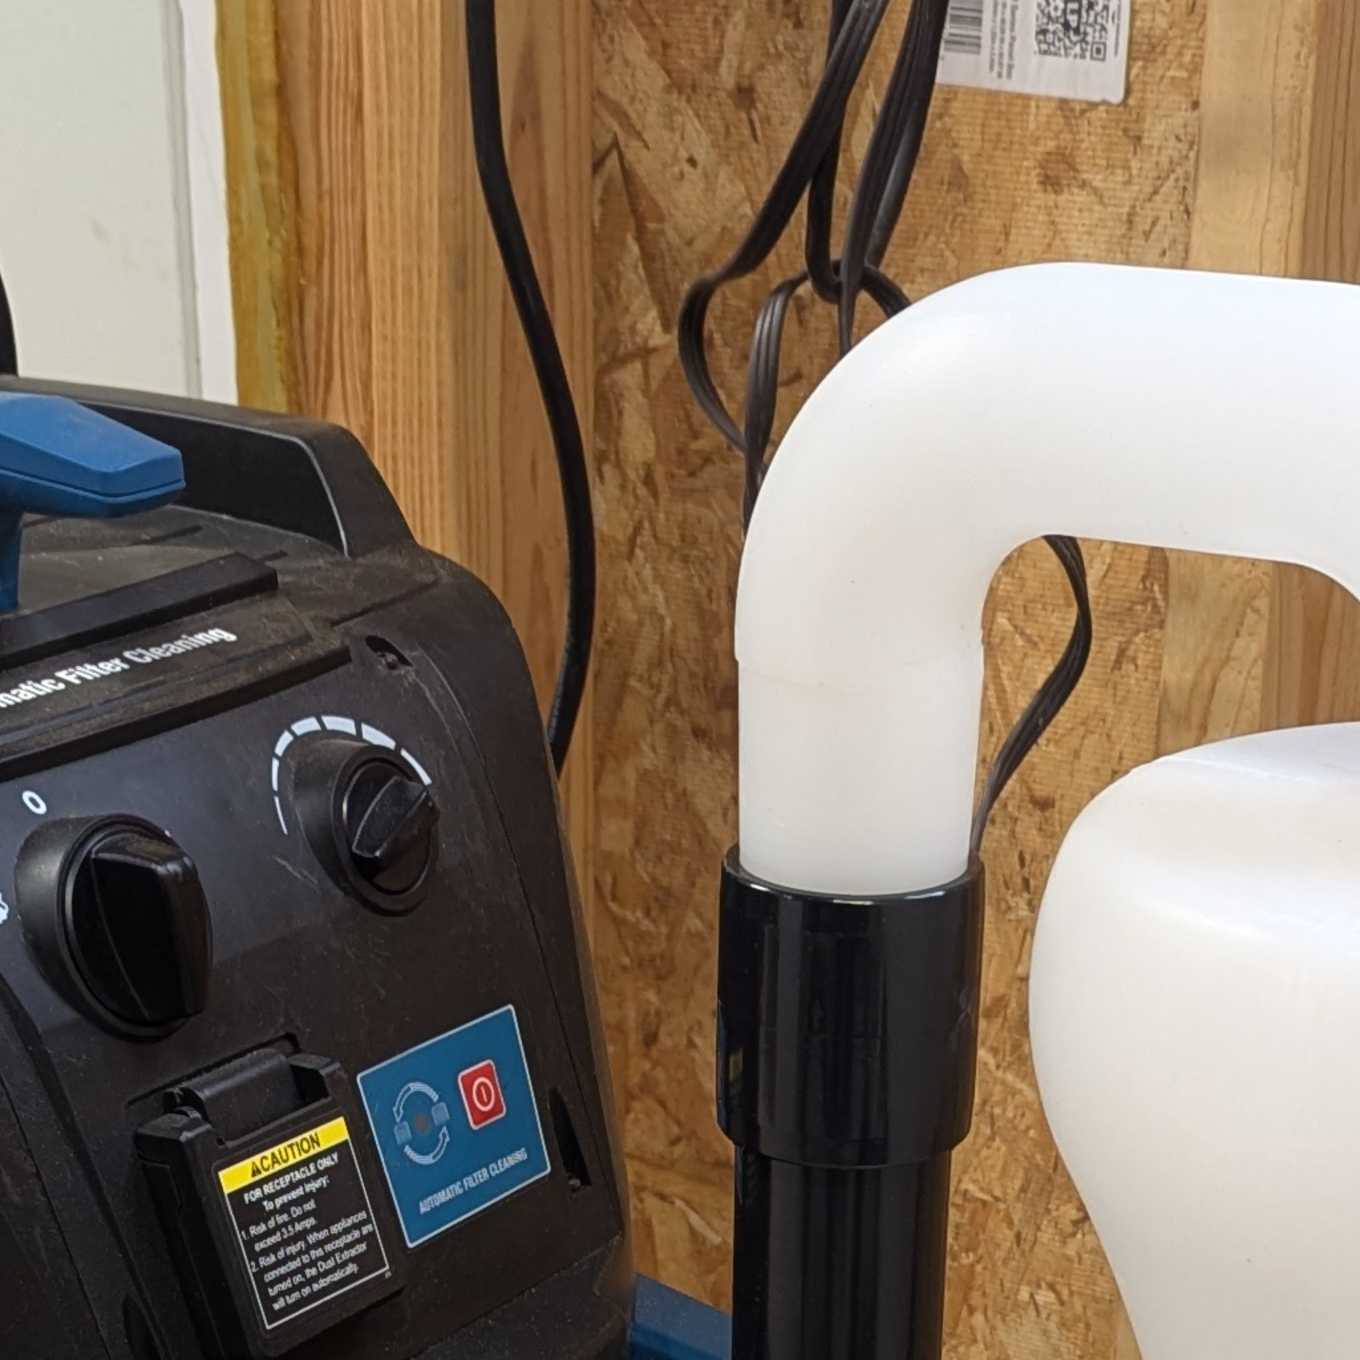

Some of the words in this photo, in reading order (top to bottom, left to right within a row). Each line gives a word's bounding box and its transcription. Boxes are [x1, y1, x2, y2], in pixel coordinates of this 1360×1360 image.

[55, 656, 130, 684] Filter
[123, 627, 237, 664] Cleaning
[243, 1188, 262, 1204] FOR
[262, 1165, 317, 1197] RECEPTACLE
[317, 1152, 339, 1171] ONLY
[258, 1132, 320, 1174] CAUTION
[262, 1199, 273, 1211] To
[274, 1185, 304, 1210] prevent
[419, 1181, 463, 1215] AUTOMATIC
[463, 1167, 490, 1191] FILTER
[489, 1147, 528, 1175] CLEANING
[249, 1223, 267, 1238] Risk
[290, 1205, 302, 1217] Do
[302, 1199, 316, 1211] not
[254, 1233, 282, 1252] exceed
[281, 1225, 295, 1239] 3.5
[258, 1254, 277, 1268] Risk
[307, 1226, 330, 1246] When
[329, 1210, 367, 1236] appliances
[263, 1256, 302, 1283] connected
[309, 1244, 324, 1260] this
[324, 1229, 361, 1254] receptacle
[267, 1277, 293, 1296] turned
[304, 1265, 318, 1280] the
[318, 1257, 335, 1273] Dust
[335, 1241, 368, 1263] Extractor
[272, 1296, 285, 1311] will
[285, 1291, 301, 1305] turn
[300, 1284, 312, 1296] on
